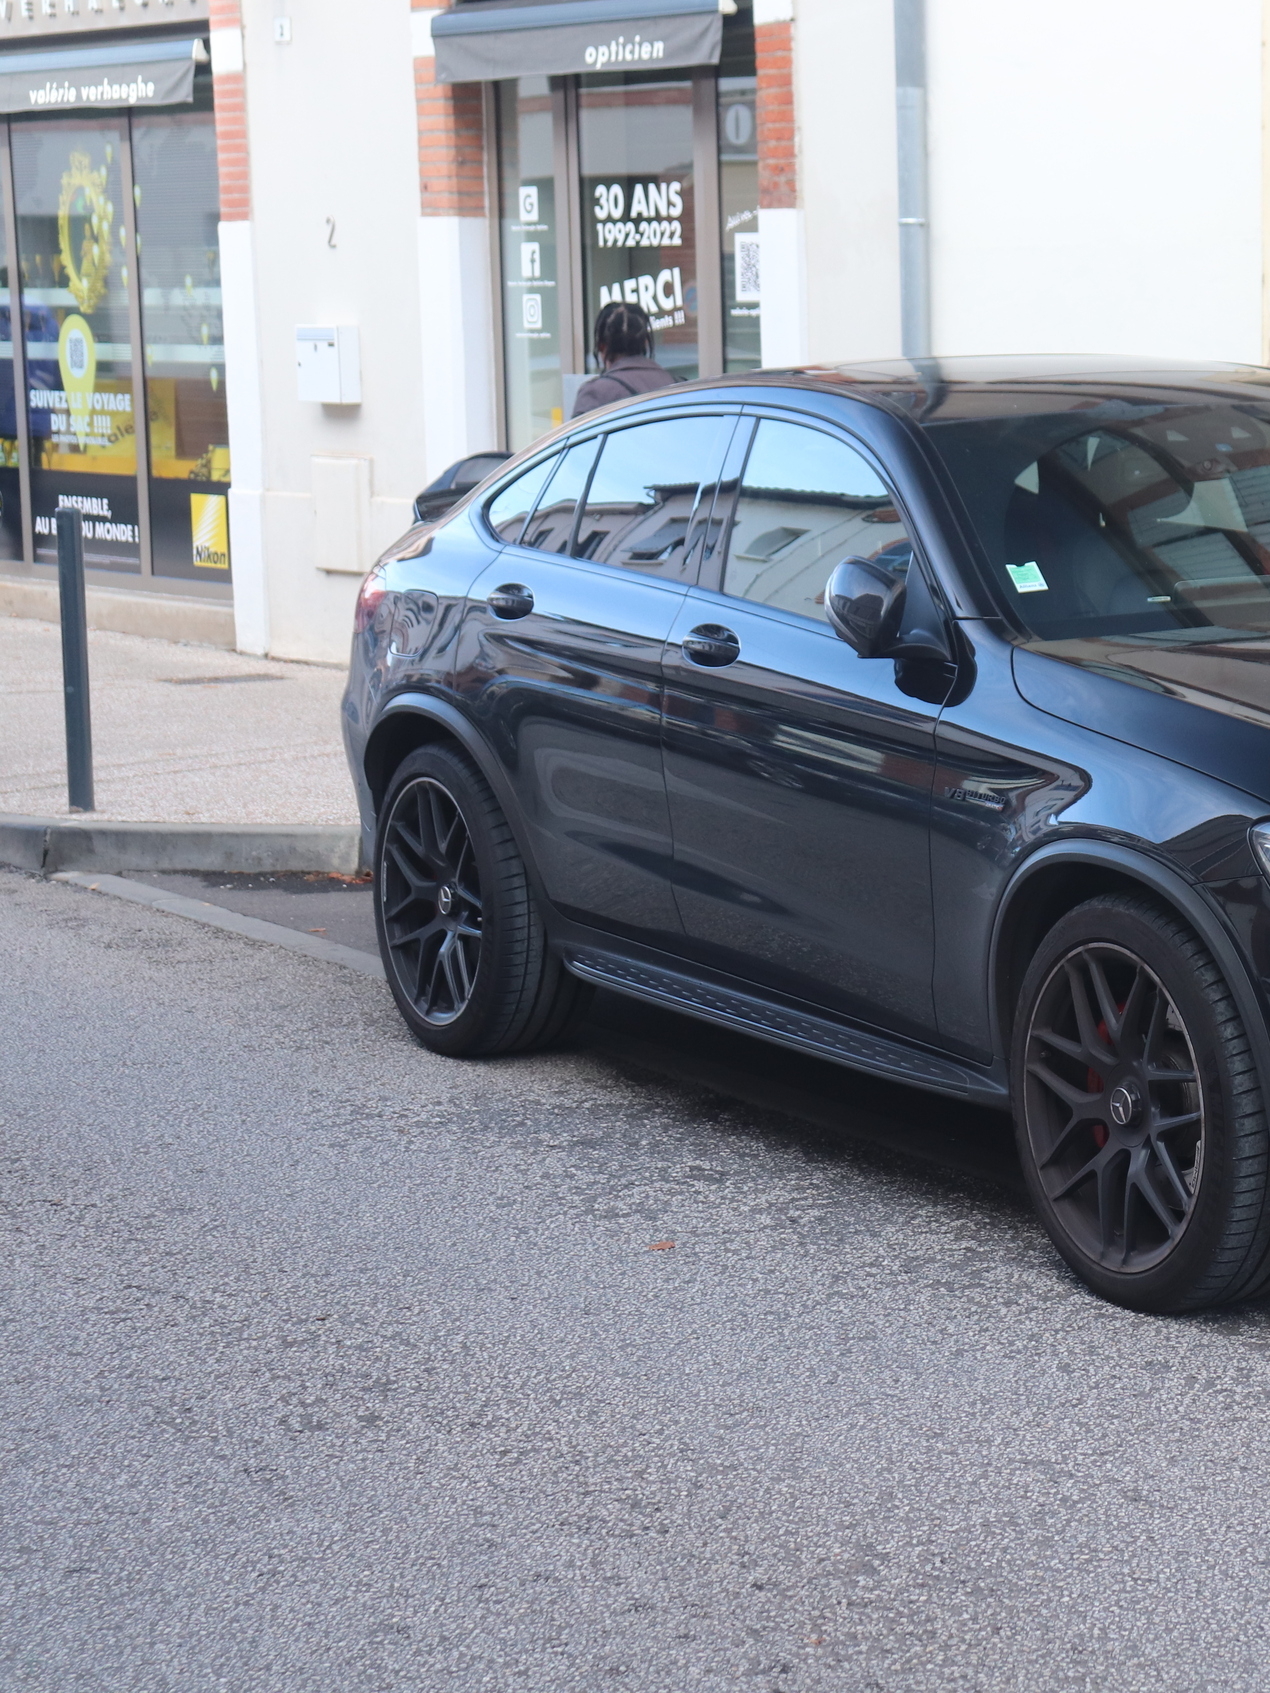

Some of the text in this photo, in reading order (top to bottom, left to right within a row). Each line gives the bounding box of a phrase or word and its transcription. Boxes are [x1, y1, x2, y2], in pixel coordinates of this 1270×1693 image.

[585, 35, 664, 69] opticien
[29, 75, 155, 105] valérie verhaeghe
[594, 181, 683, 220] 30 ANS
[597, 220, 682, 248] 1992-2022
[600, 266, 683, 314] MERCI
[30, 389, 132, 412] SUIVEZ LE VOYAGE
[50, 413, 66, 432] DU
[70, 415, 90, 432] SAC
[35, 516, 49, 534] AU
[95, 522, 133, 543] MONDE
[194, 546, 226, 565] Nikon
[966, 790, 1006, 804] BITURBO
